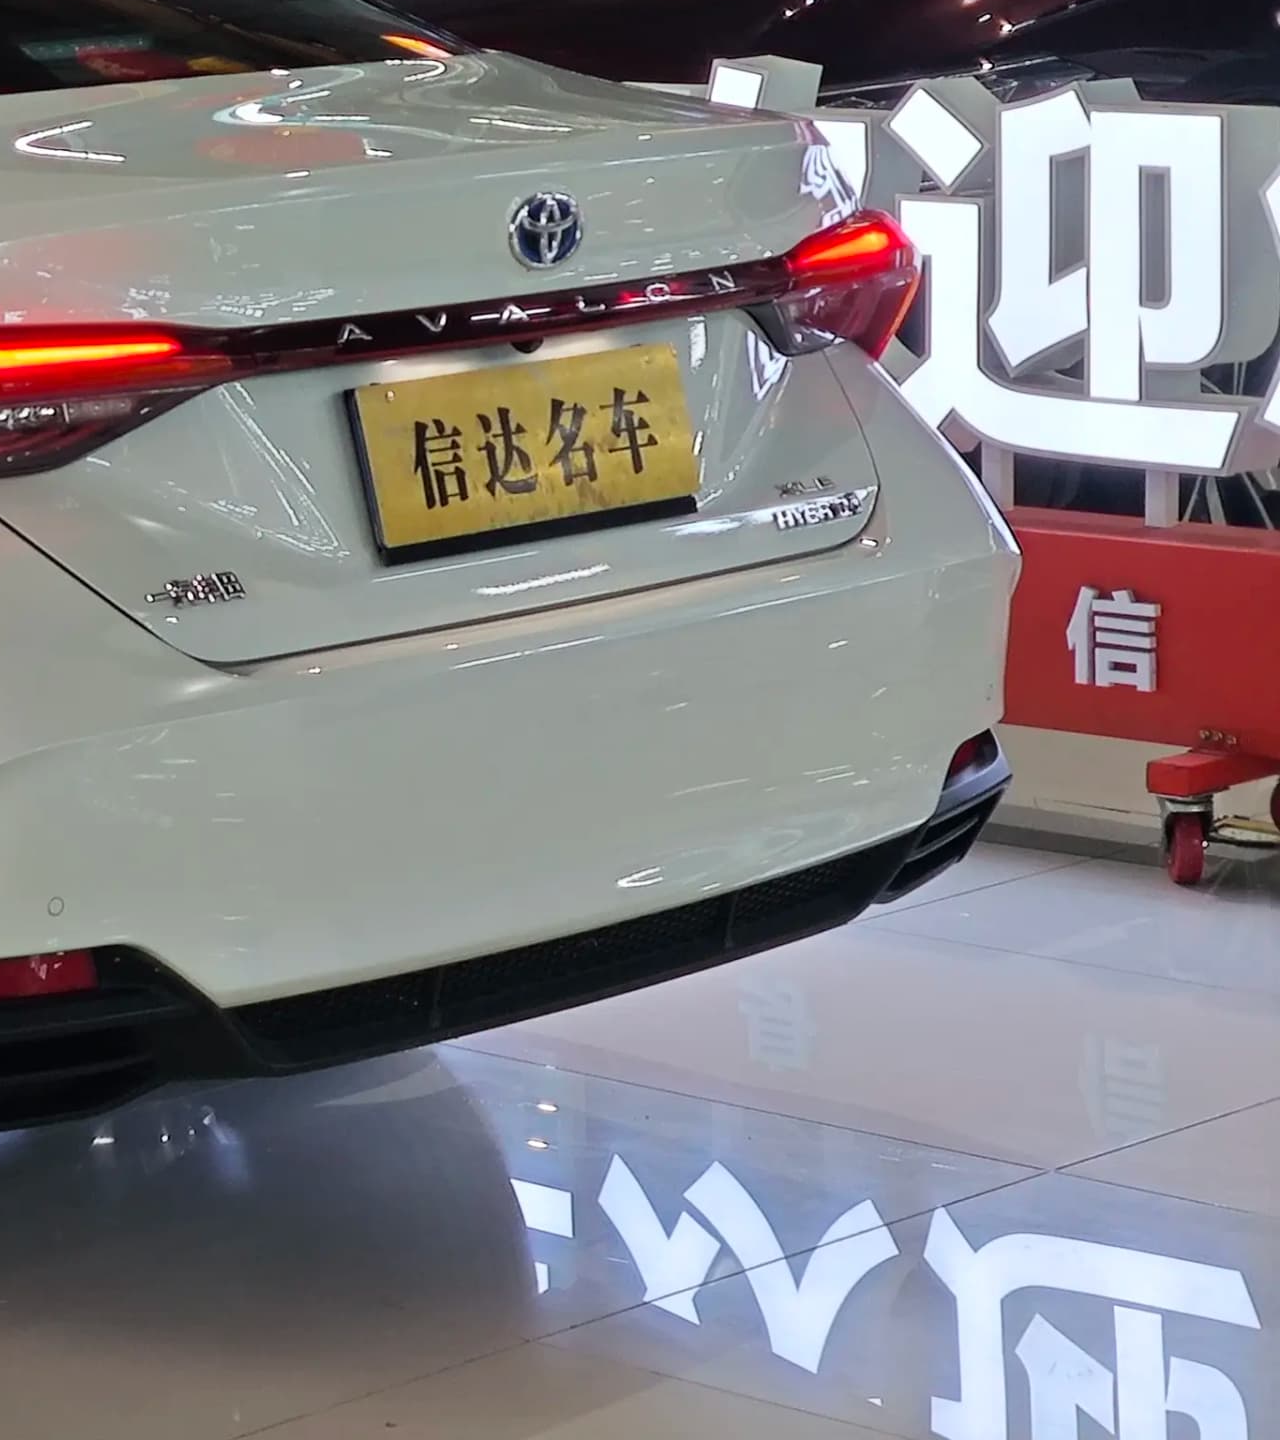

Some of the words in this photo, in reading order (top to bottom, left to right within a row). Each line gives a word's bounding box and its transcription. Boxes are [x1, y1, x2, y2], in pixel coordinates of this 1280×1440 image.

[337, 268, 737, 346] AVALON
[412, 386, 659, 511] 信达名车
[1065, 585, 1162, 693] 信
